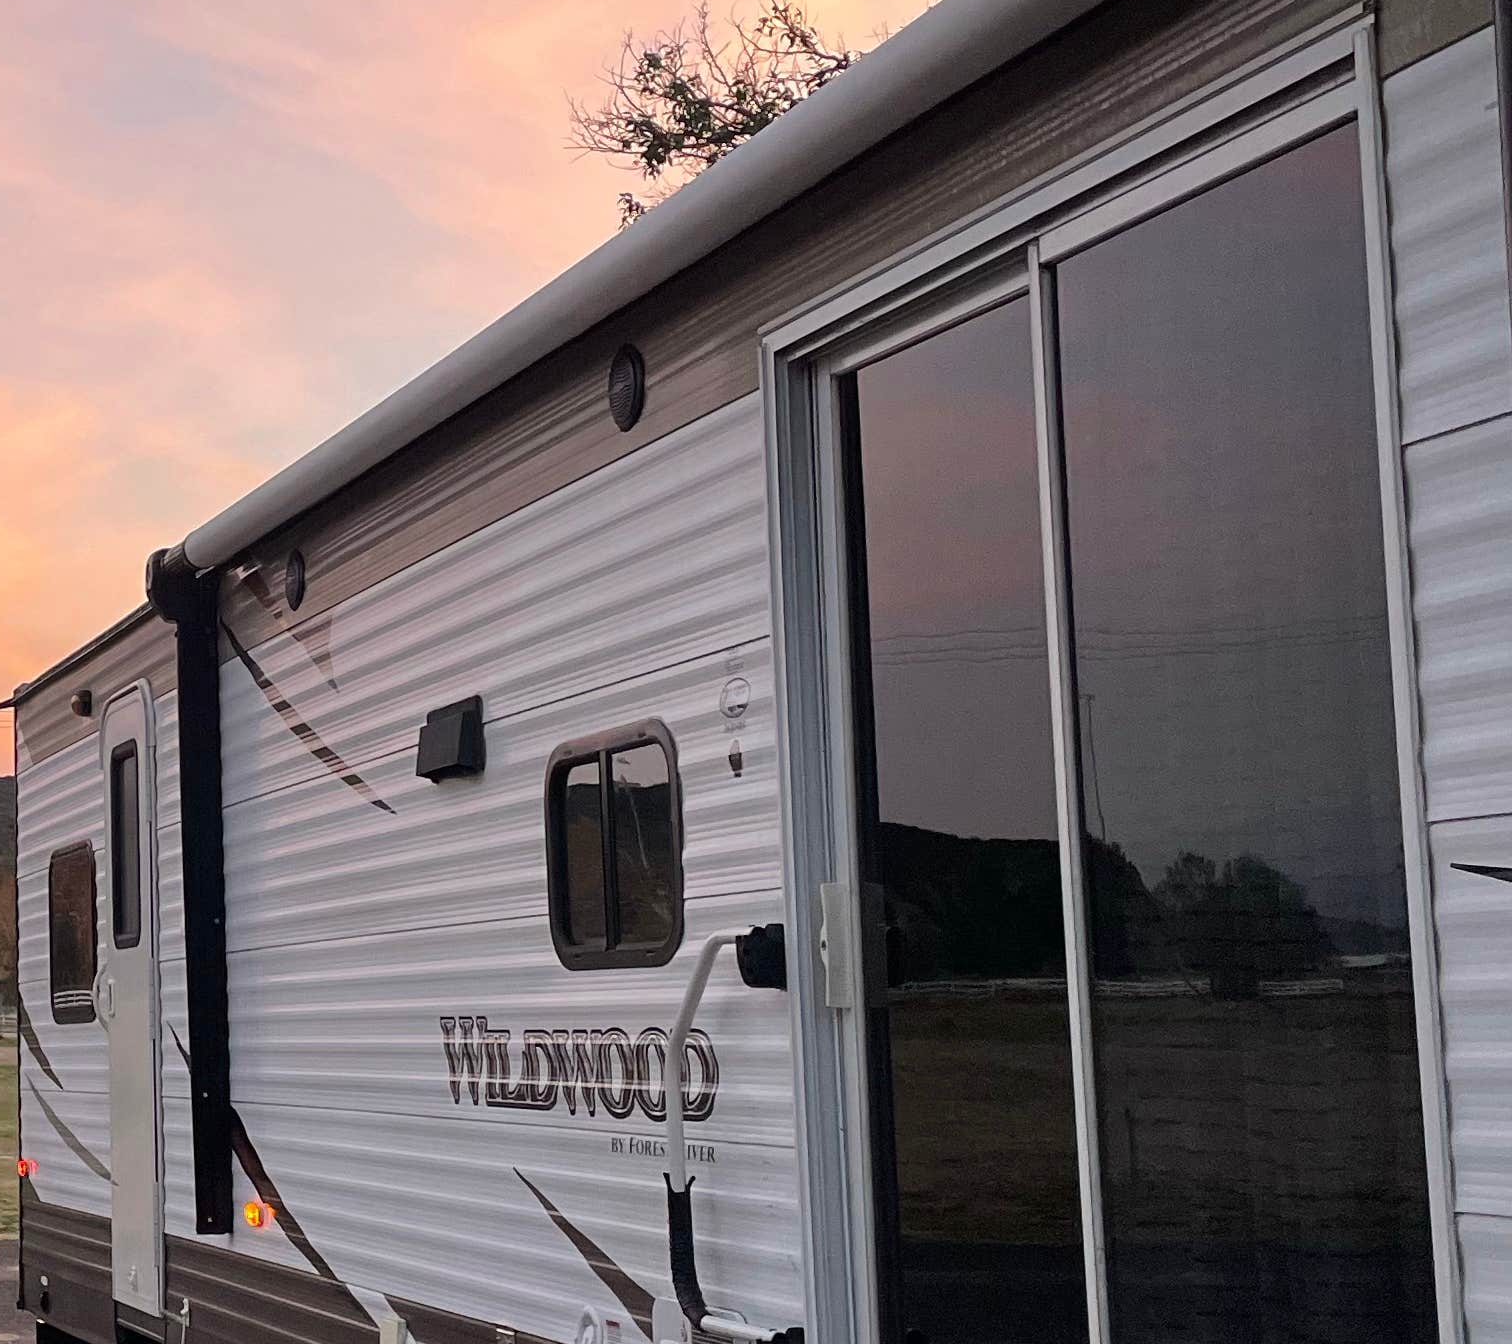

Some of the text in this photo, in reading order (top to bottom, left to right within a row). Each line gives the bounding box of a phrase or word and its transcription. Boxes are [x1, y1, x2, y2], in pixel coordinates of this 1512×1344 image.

[440, 1016, 719, 1122] WILDWOOD
[611, 1137, 716, 1163] BY FORES IVER
